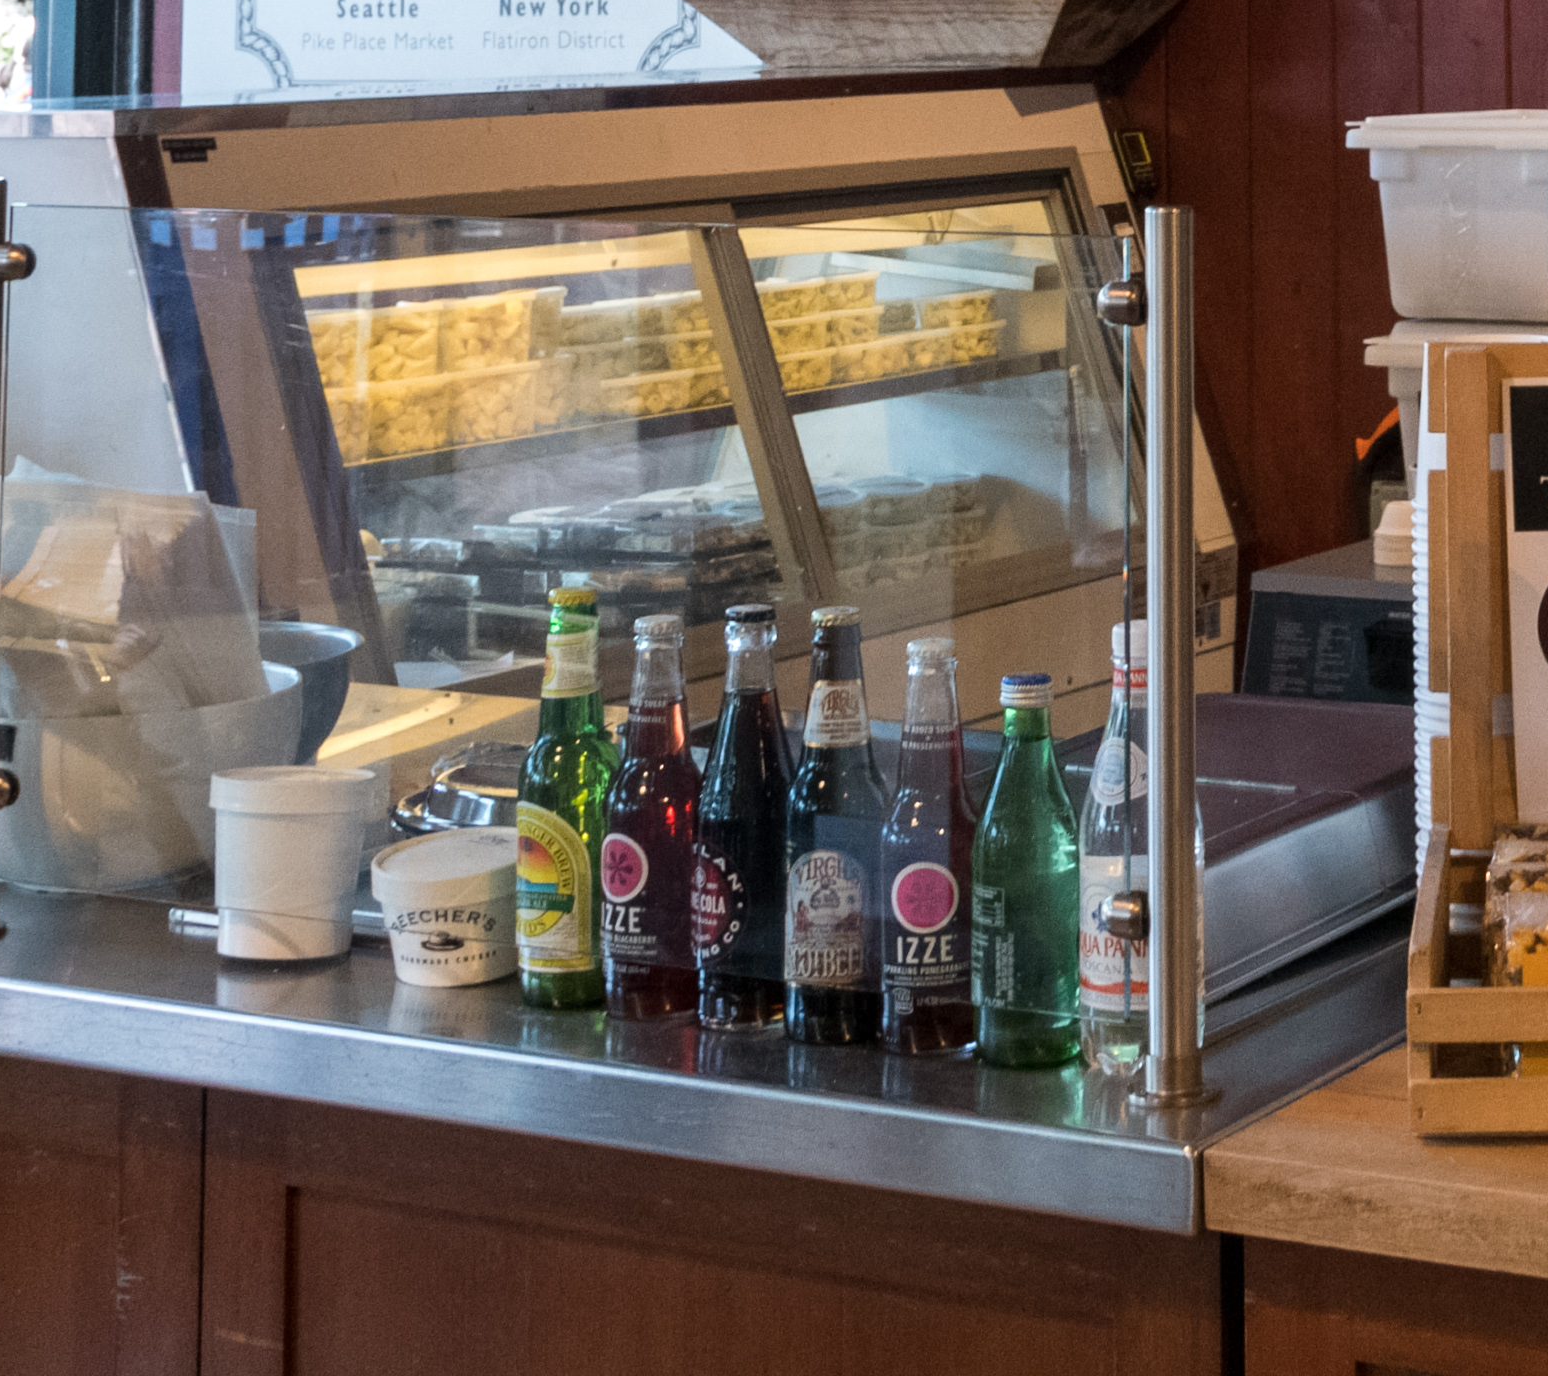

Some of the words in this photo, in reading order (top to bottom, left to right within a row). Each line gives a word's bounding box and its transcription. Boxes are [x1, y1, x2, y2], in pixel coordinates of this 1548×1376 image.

[302, 32, 336, 51] Pike
[343, 32, 386, 51] Place
[394, 31, 453, 50] Market
[482, 30, 549, 50] Flatiron
[558, 29, 625, 49] District
[898, 935, 954, 964] IZZE
